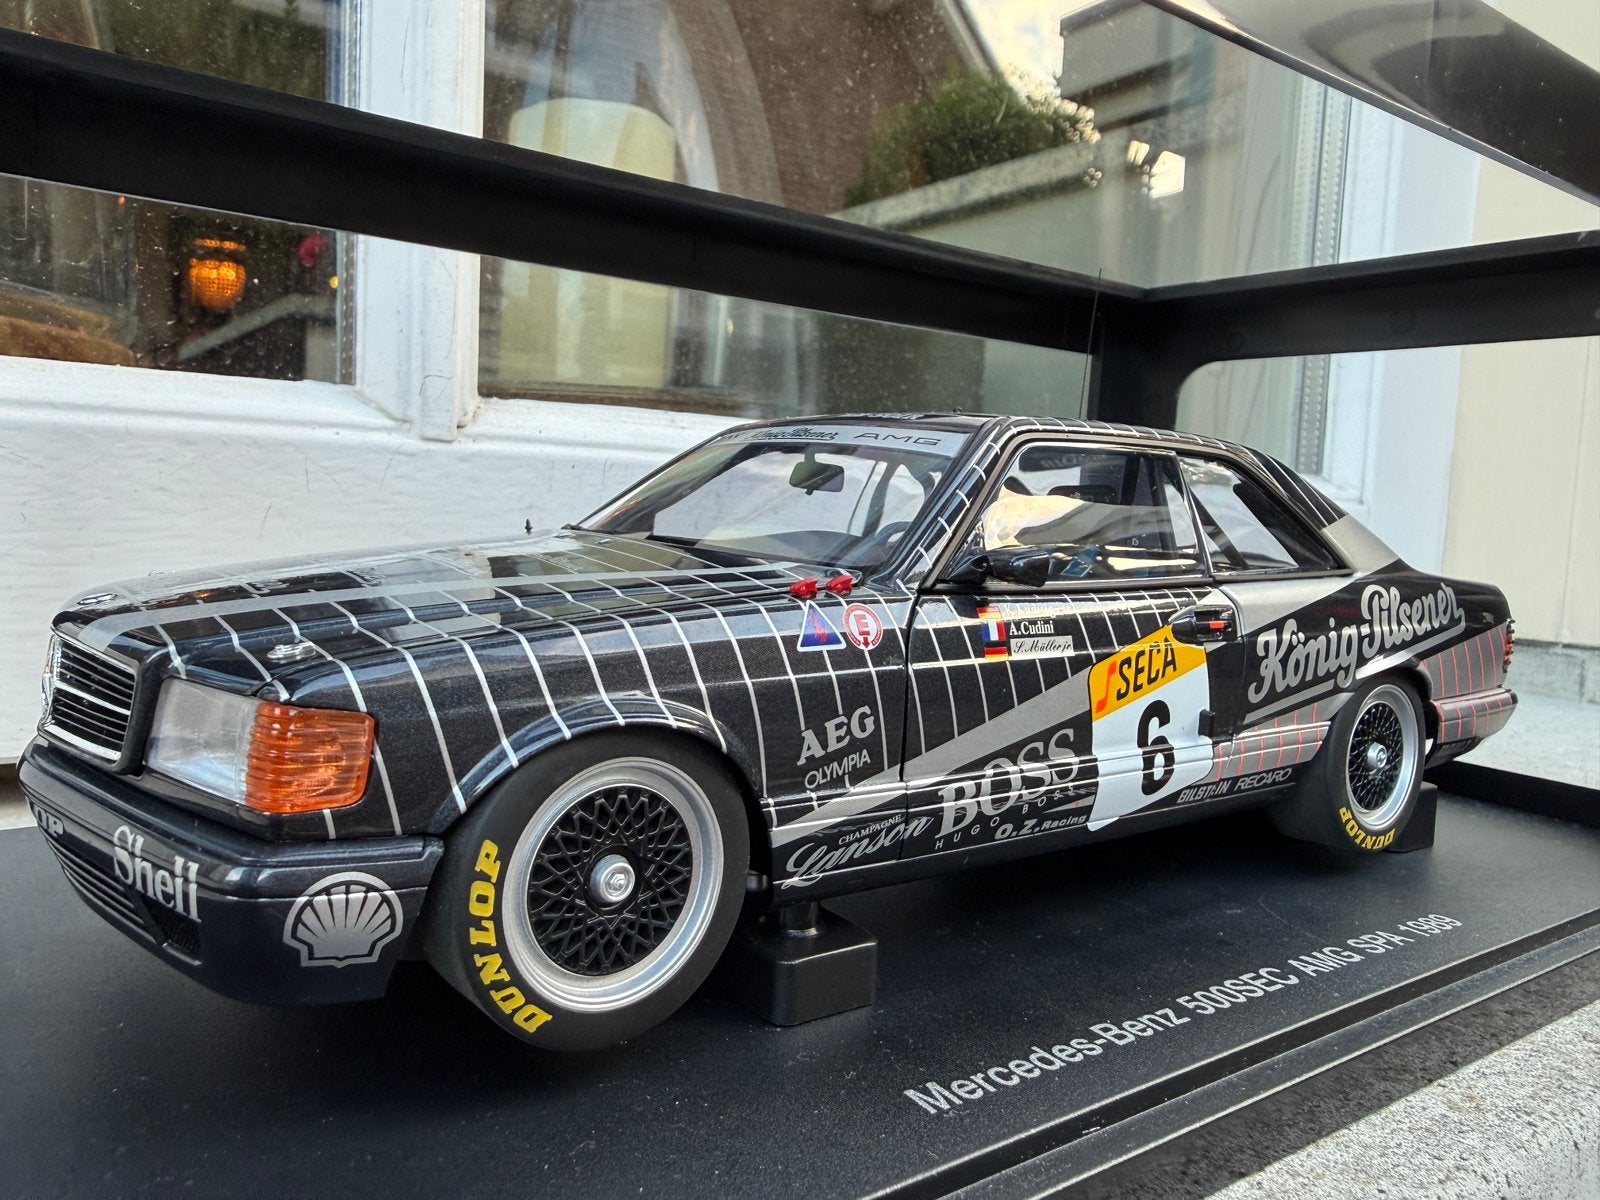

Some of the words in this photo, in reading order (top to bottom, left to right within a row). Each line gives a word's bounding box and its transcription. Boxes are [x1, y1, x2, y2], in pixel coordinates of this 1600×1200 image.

[853, 431, 942, 446] AMG
[1009, 620, 1055, 636] A.Cudini
[1247, 582, 1466, 704] König-Pilsener
[1116, 637, 1178, 702] SECA
[797, 704, 876, 766] AEG
[1136, 699, 1175, 796] 6
[804, 749, 871, 789] OLYMPIA
[935, 728, 1080, 839] BOSS
[1234, 767, 1292, 792] RECARO
[780, 816, 935, 889] Lanson
[838, 814, 906, 846] CHAMPAGNE
[1339, 806, 1396, 850] DUNLOP
[112, 824, 202, 923] Shell
[468, 839, 553, 1034] DUNLOP
[903, 1007, 1191, 1115] Mercedes-Benz
[1176, 967, 1300, 1015] 500SEC
[1287, 946, 1366, 977] AMG
[1346, 930, 1415, 954] SPA
[1397, 914, 1463, 937] 1989
